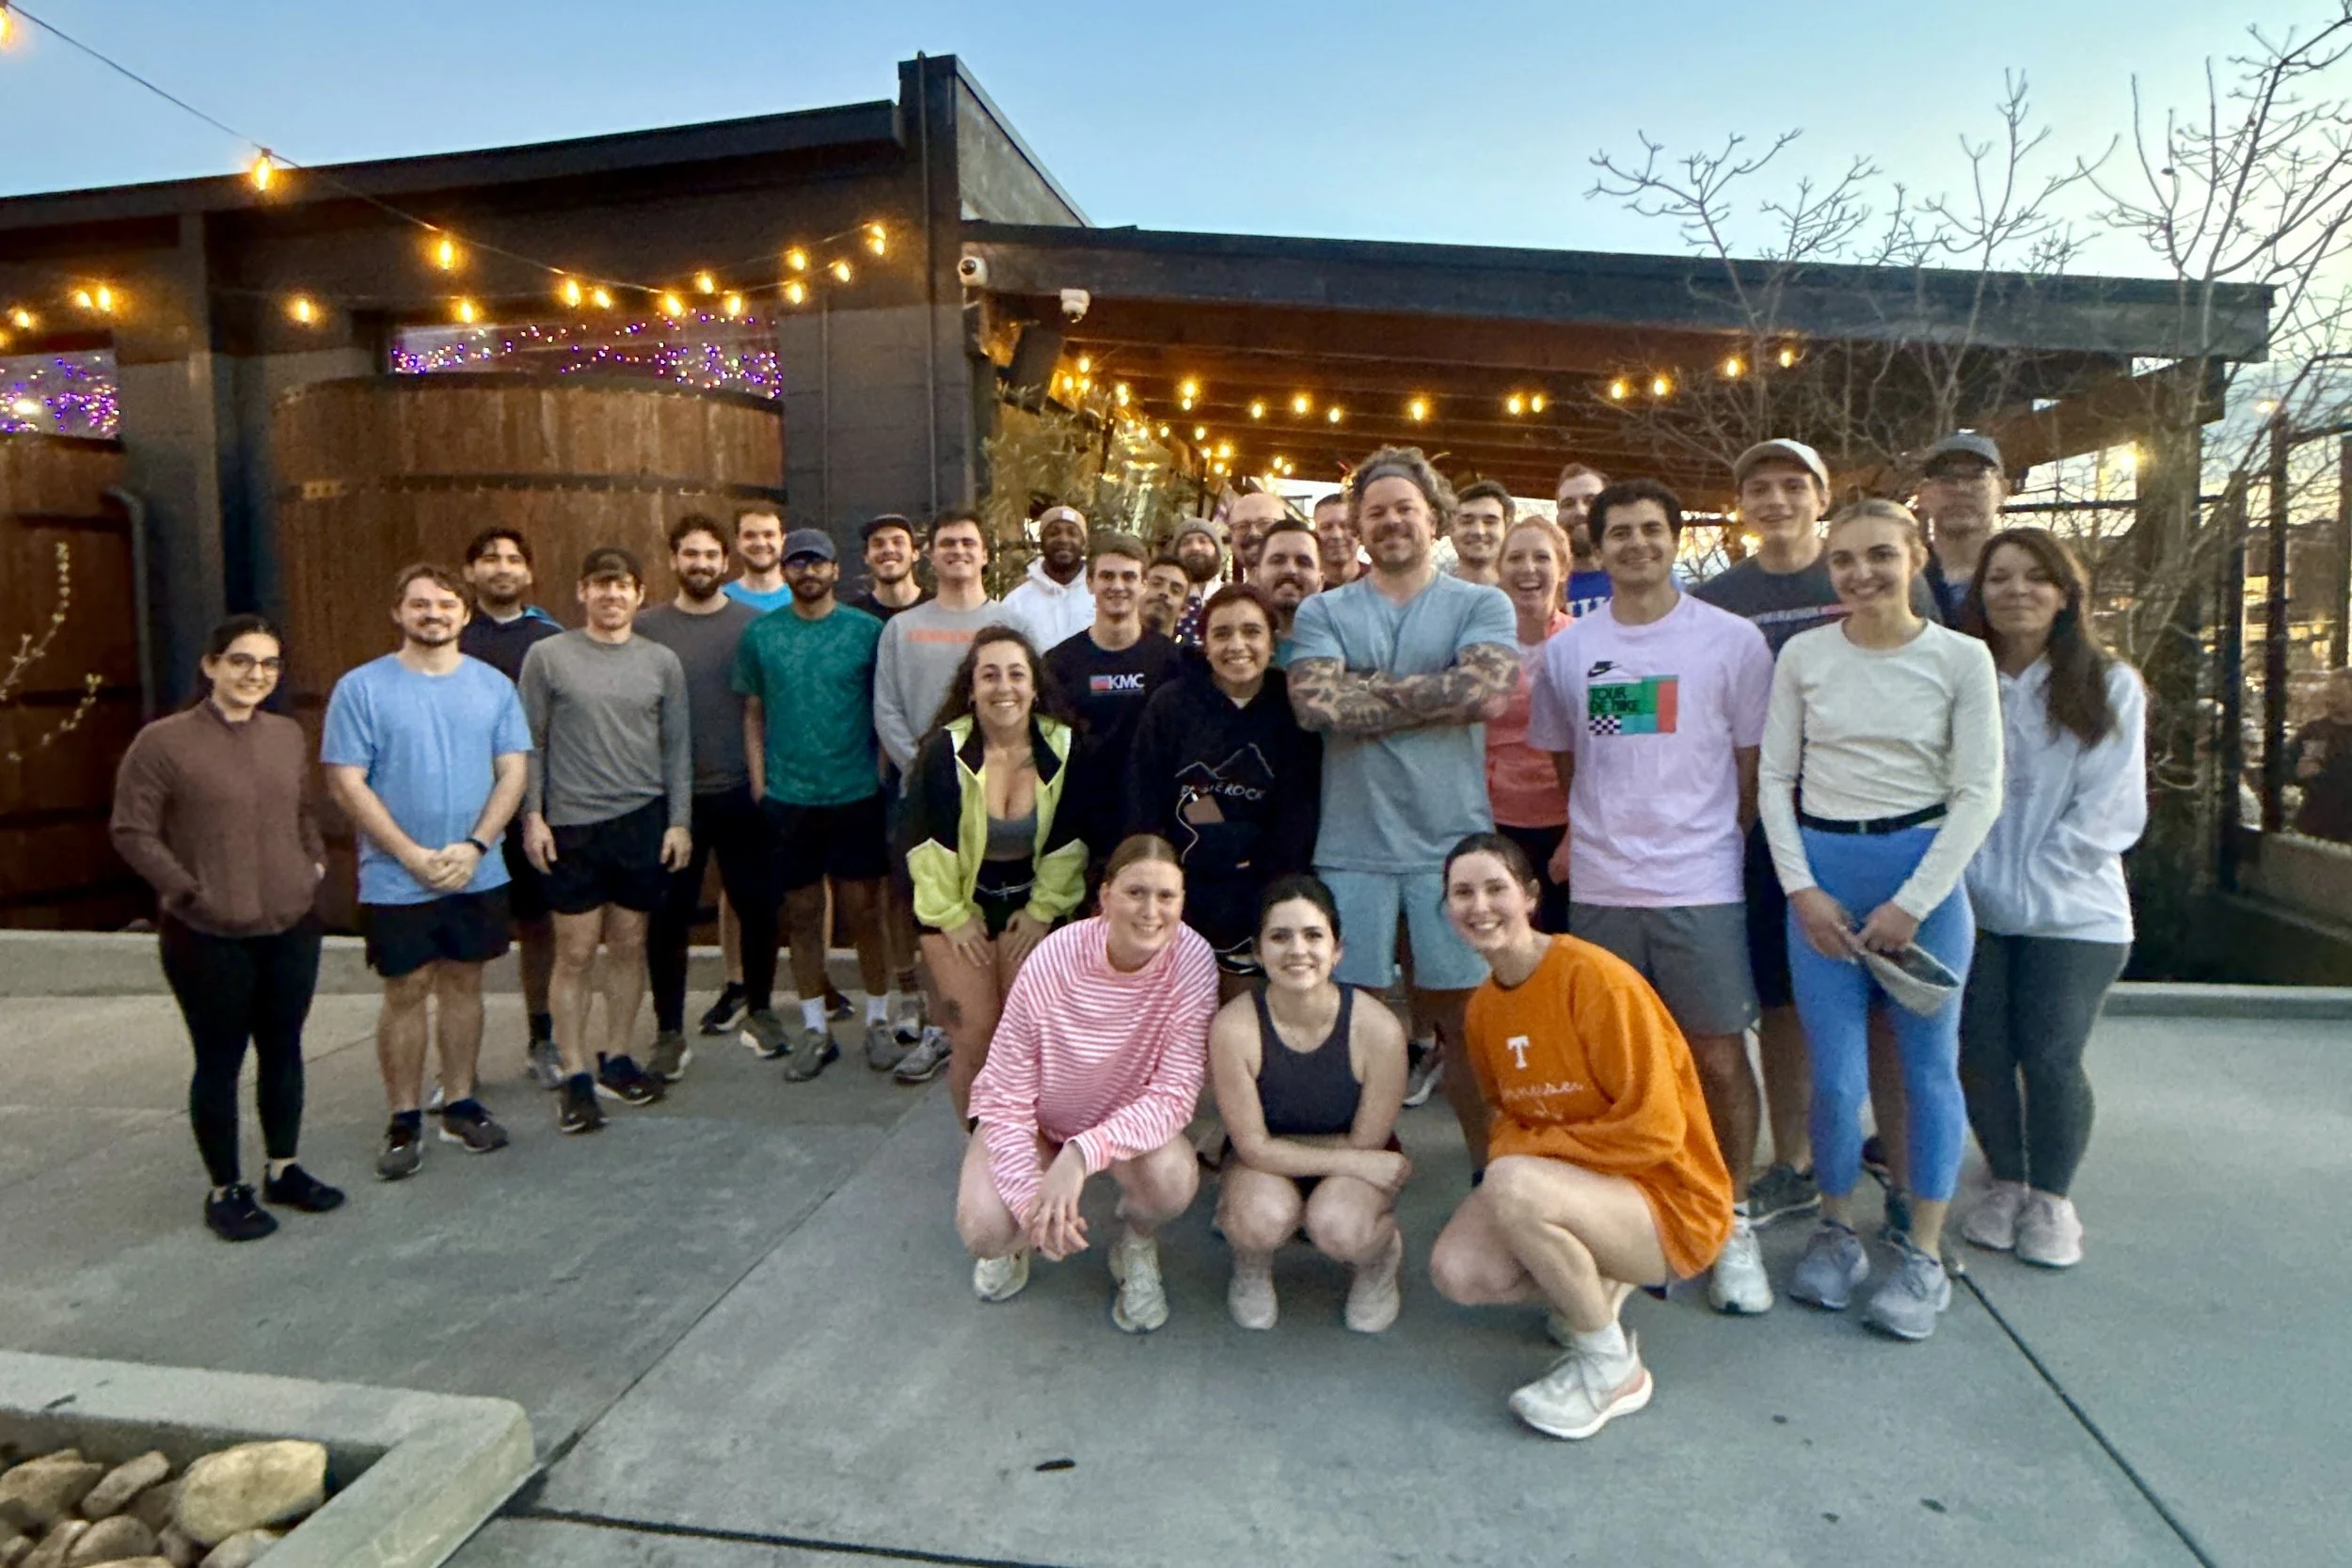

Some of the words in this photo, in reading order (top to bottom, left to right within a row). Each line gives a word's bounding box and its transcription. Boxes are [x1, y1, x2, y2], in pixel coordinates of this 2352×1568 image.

[1109, 673, 1145, 689] KMC
[1590, 687, 1626, 701] TOUR
[1224, 783, 1265, 800] ROCK
[1506, 1035, 1531, 1069] T
